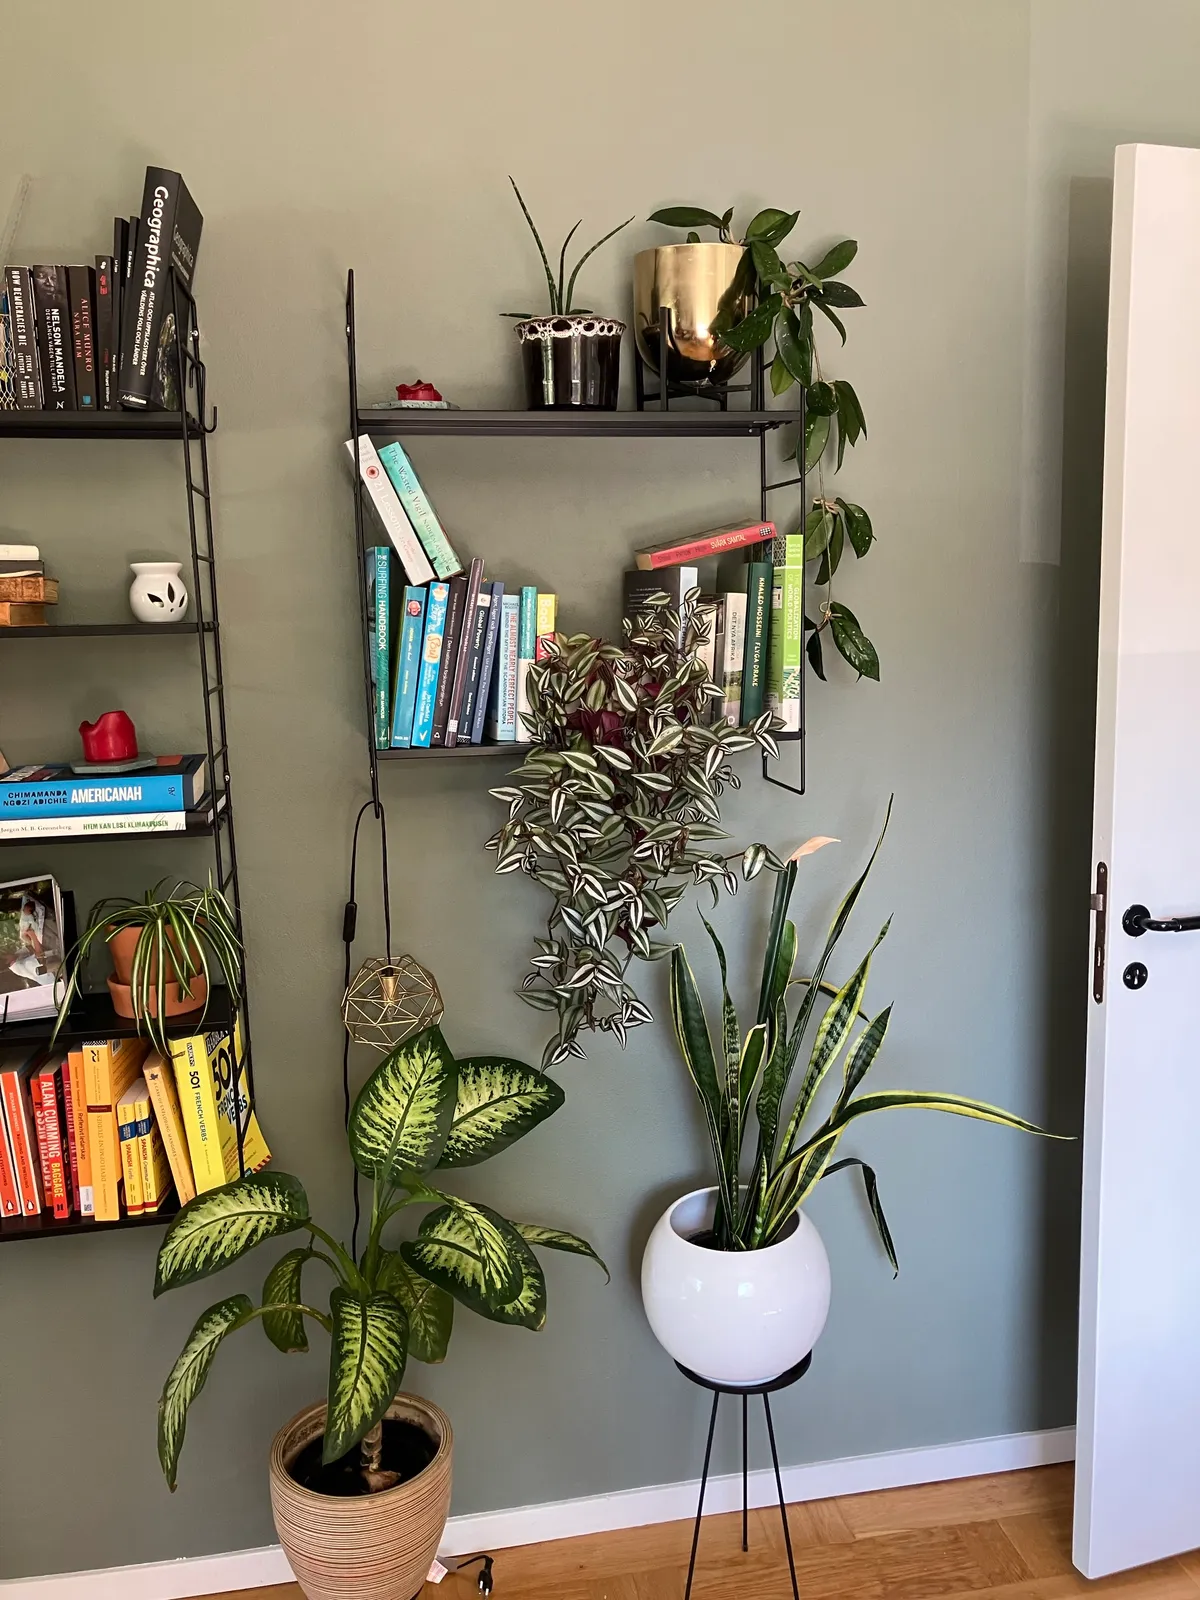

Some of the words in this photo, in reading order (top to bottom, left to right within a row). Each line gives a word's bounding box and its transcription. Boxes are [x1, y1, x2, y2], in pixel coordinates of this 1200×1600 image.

[144, 186, 168, 288] Geographica
[12, 270, 20, 284] HOW
[14, 287, 25, 333] DEMOCRACIES
[81, 298, 90, 328] ALICE
[138, 290, 147, 317] VÄRLDENS
[18, 335, 27, 346] DIE
[51, 309, 61, 346] NELSON
[142, 322, 152, 360] UPPSLAGSVERK
[84, 332, 92, 372] MUNRO
[132, 344, 140, 365] LÄNDER
[55, 348, 65, 393] MANDELA
[389, 447, 399, 465] The
[398, 466, 415, 495] Wasted
[412, 496, 427, 517] Vigil
[374, 481, 384, 492] 21
[381, 495, 402, 532] Lessons
[710, 539, 726, 549] SVÅRA
[726, 534, 746, 544] SAMTAL
[378, 560, 387, 598] SURFING
[378, 600, 387, 650] HANDBOOK
[540, 600, 552, 634] Book
[756, 606, 764, 638] HOSSEINI
[427, 636, 441, 659] Soul
[474, 629, 483, 650] Poverty
[508, 649, 516, 673] NEARLY
[507, 674, 516, 701] PERFECT
[752, 664, 760, 687] DRAKE
[506, 702, 515, 725] PEOPLE
[8, 790, 67, 798] CHIMAMANDA
[71, 786, 142, 803] AMERICANAH
[128, 820, 168, 829] KLIMAKRISEN
[190, 1071, 200, 1089] 501
[212, 1044, 234, 1101] 50
[41, 1081, 55, 1107] ALAN
[195, 1092, 204, 1119] FRENCH
[217, 1088, 235, 1120] FRENC
[66, 1096, 74, 1132] VEGETARIAN
[227, 1094, 248, 1125] VEBS
[44, 1110, 60, 1158] CUMMING
[168, 1133, 177, 1157] MANGOES
[199, 1121, 208, 1142] VERBS
[52, 1162, 63, 1198] BAGGAGE
